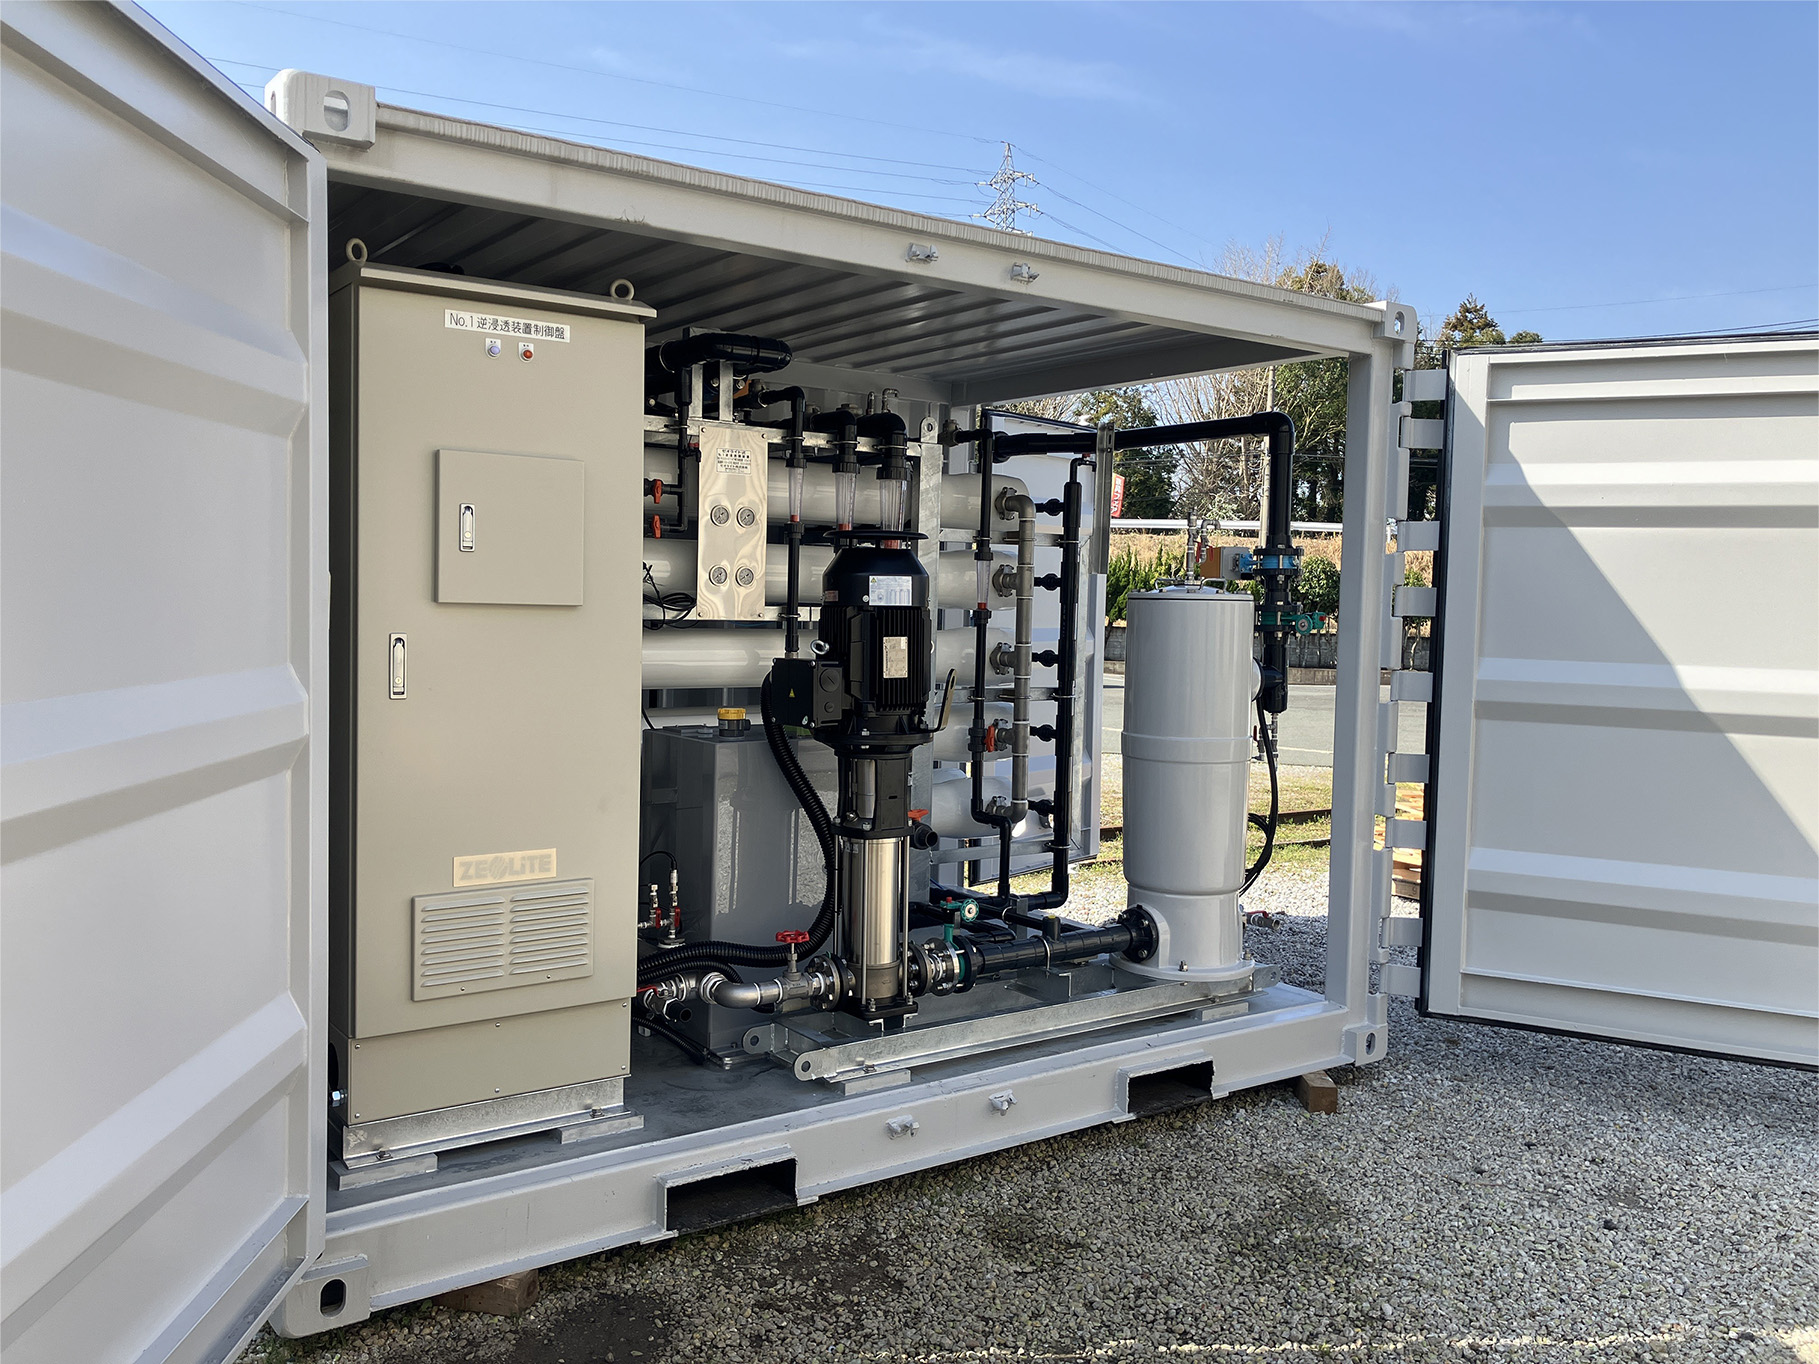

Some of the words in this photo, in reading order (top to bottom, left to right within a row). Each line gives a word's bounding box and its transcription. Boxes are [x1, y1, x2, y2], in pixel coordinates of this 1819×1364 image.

[450, 313, 474, 328] No.1
[477, 317, 565, 340] 逆浸透装置制御盤
